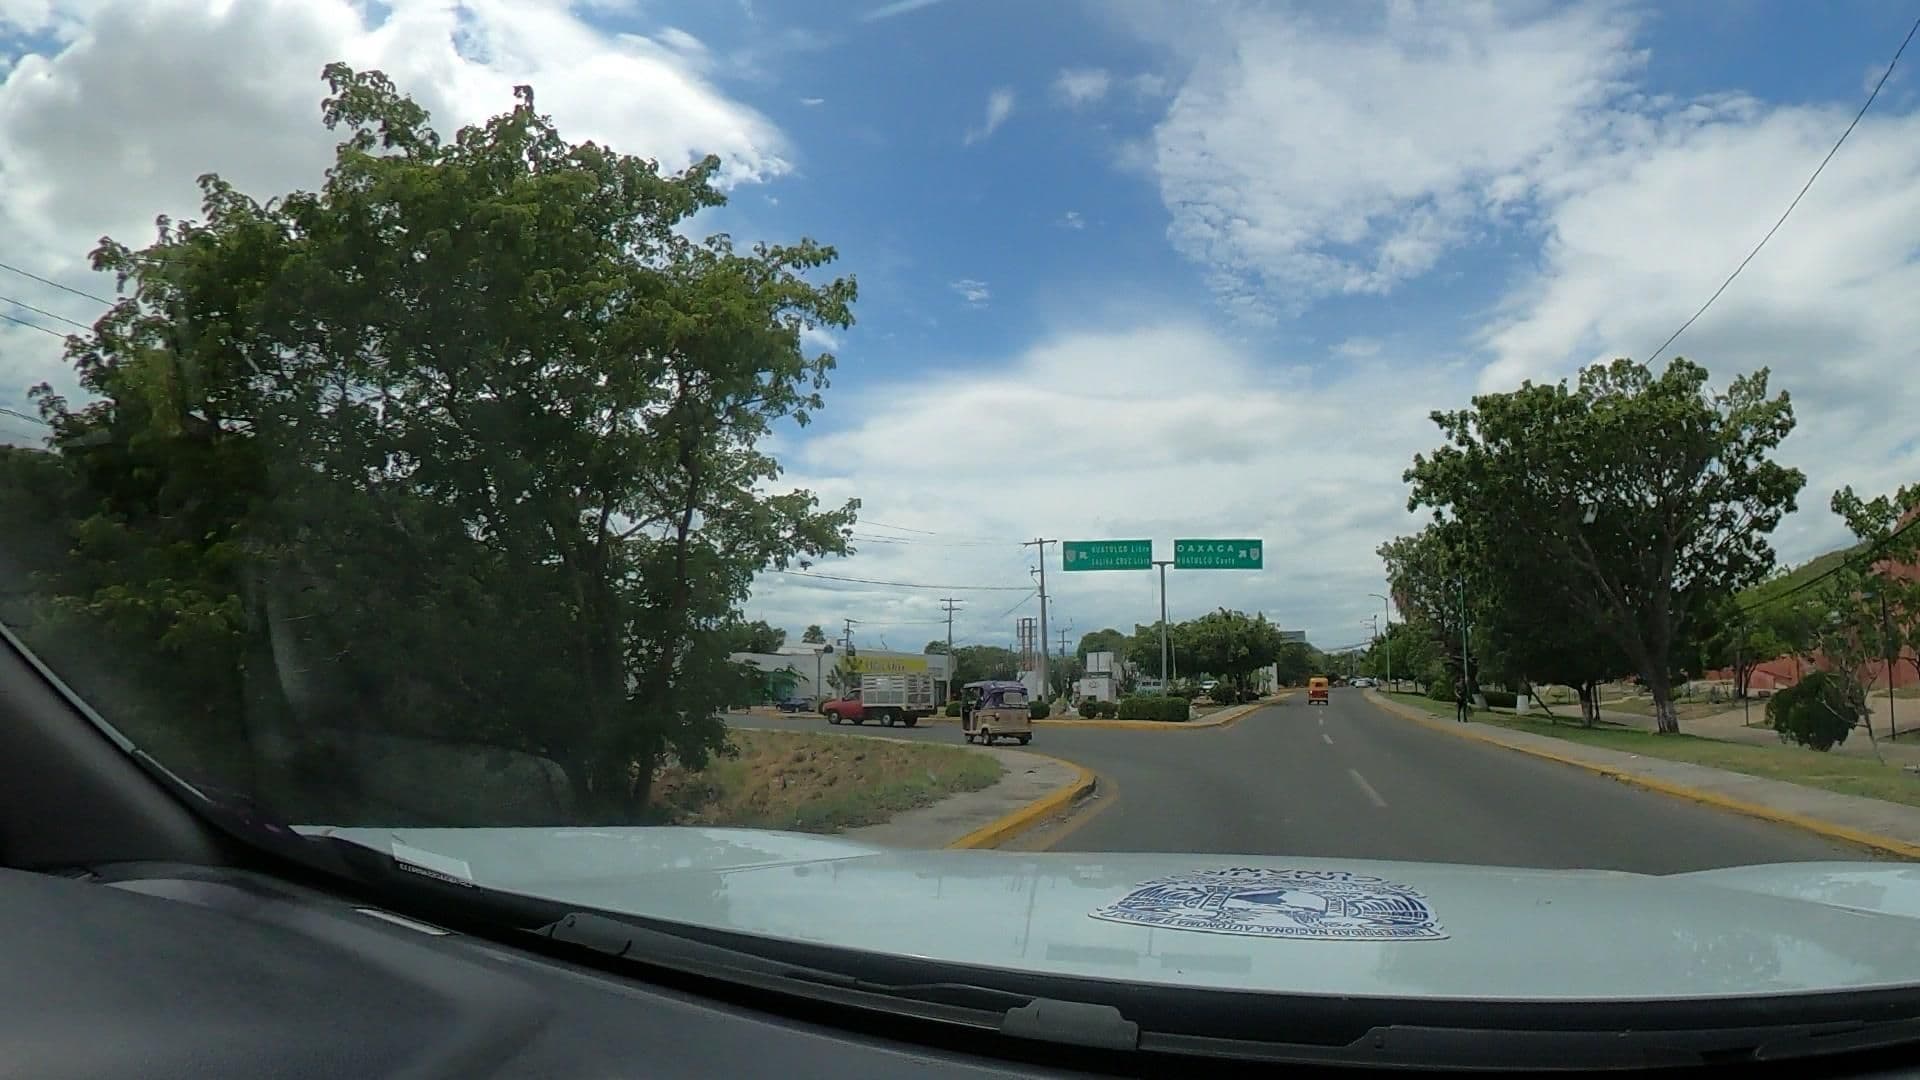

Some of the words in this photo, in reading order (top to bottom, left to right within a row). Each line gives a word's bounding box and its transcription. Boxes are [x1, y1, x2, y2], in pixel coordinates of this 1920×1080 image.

[1177, 544, 1234, 552] OAXACA
[1177, 556, 1213, 565] HUATULCO
[1259, 926, 1328, 935] NACIONAL
